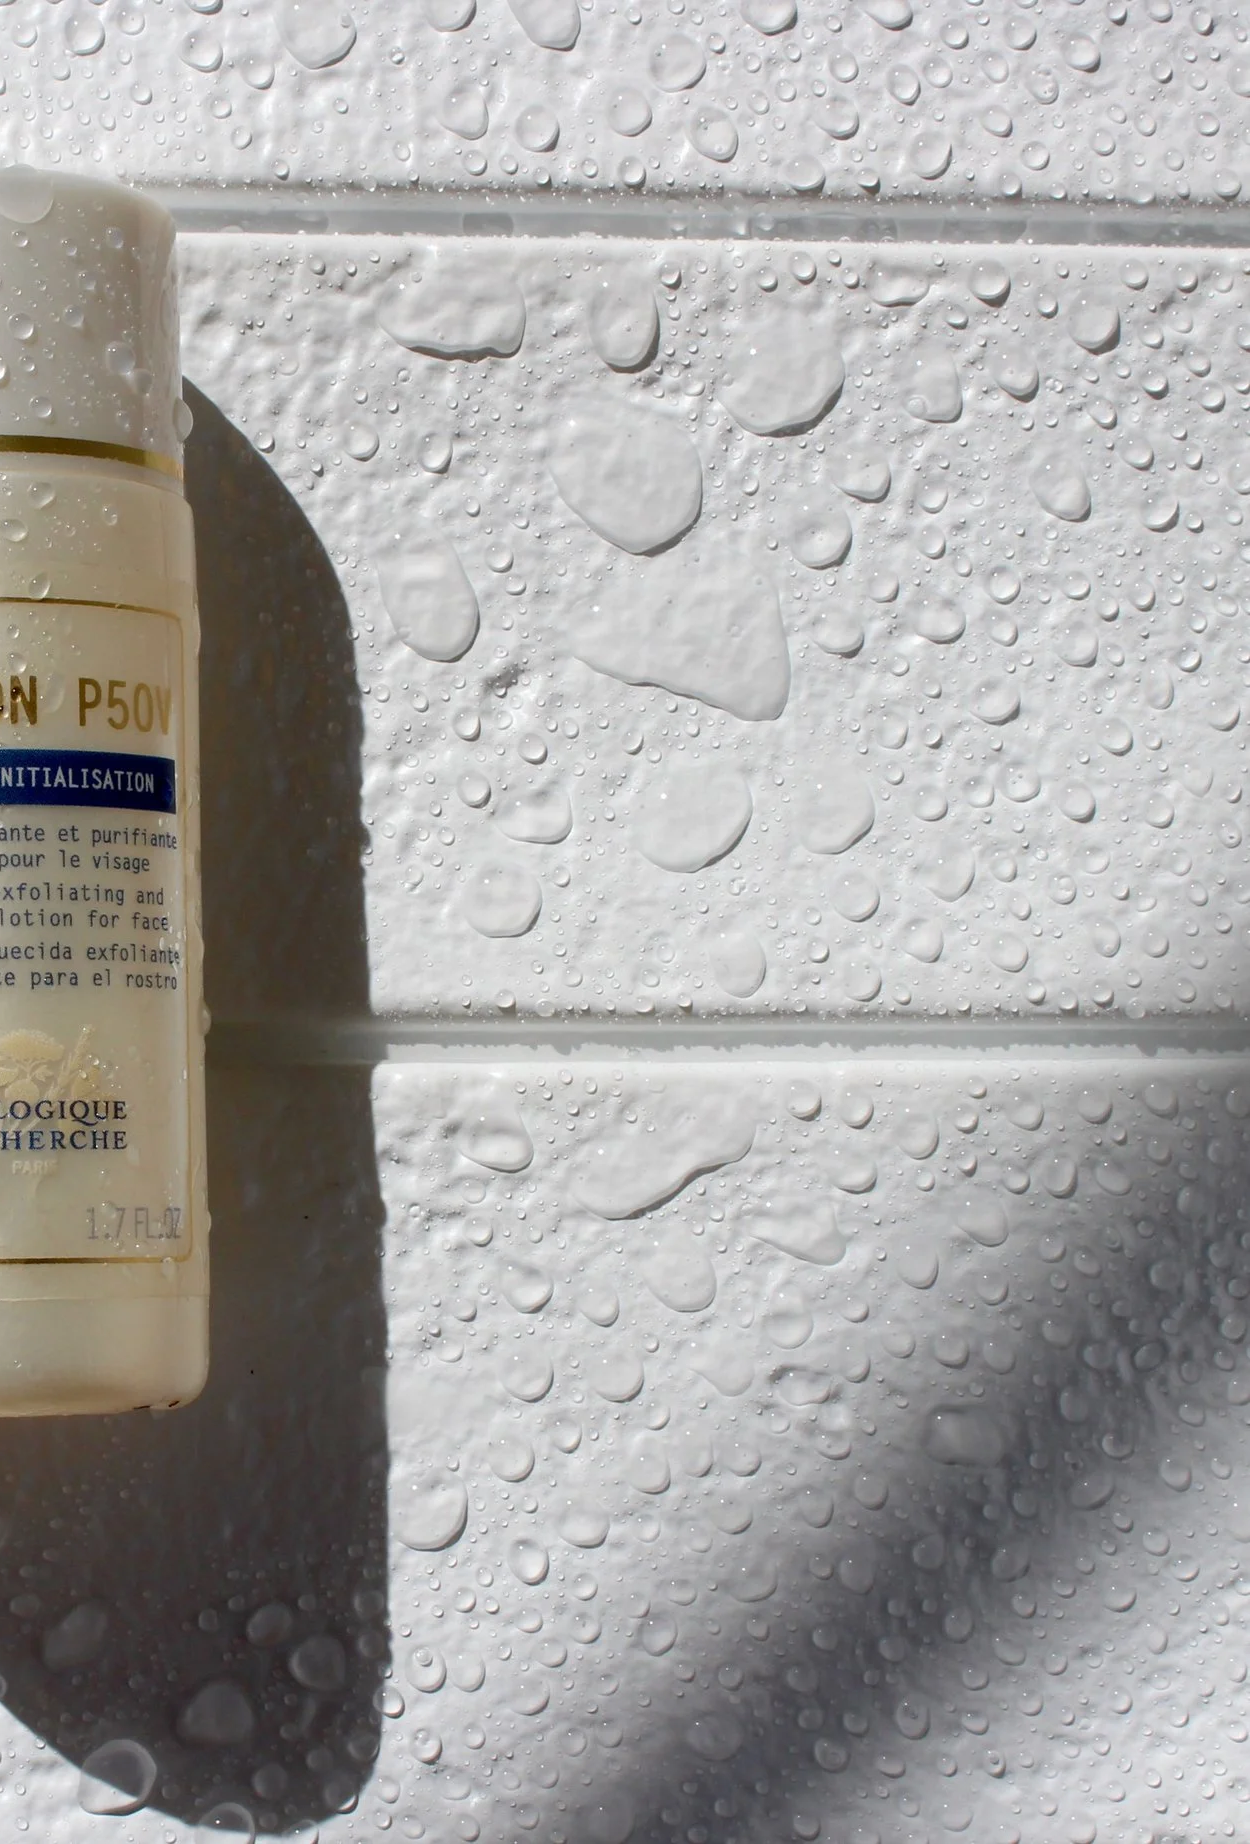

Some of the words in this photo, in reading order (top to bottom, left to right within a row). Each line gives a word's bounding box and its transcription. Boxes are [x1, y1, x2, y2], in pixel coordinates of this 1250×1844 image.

[78, 677, 172, 736] P50V
[58, 826, 80, 843] et
[91, 826, 177, 850] purifiante
[59, 850, 80, 870] le
[92, 853, 150, 873] visage
[136, 887, 164, 906] and
[87, 910, 120, 929] for
[132, 913, 169, 931] face
[86, 943, 180, 965] exfoliante
[30, 968, 78, 989] para
[92, 969, 111, 987] el
[126, 973, 177, 990] rostro
[87, 1206, 126, 1240] 1.7
